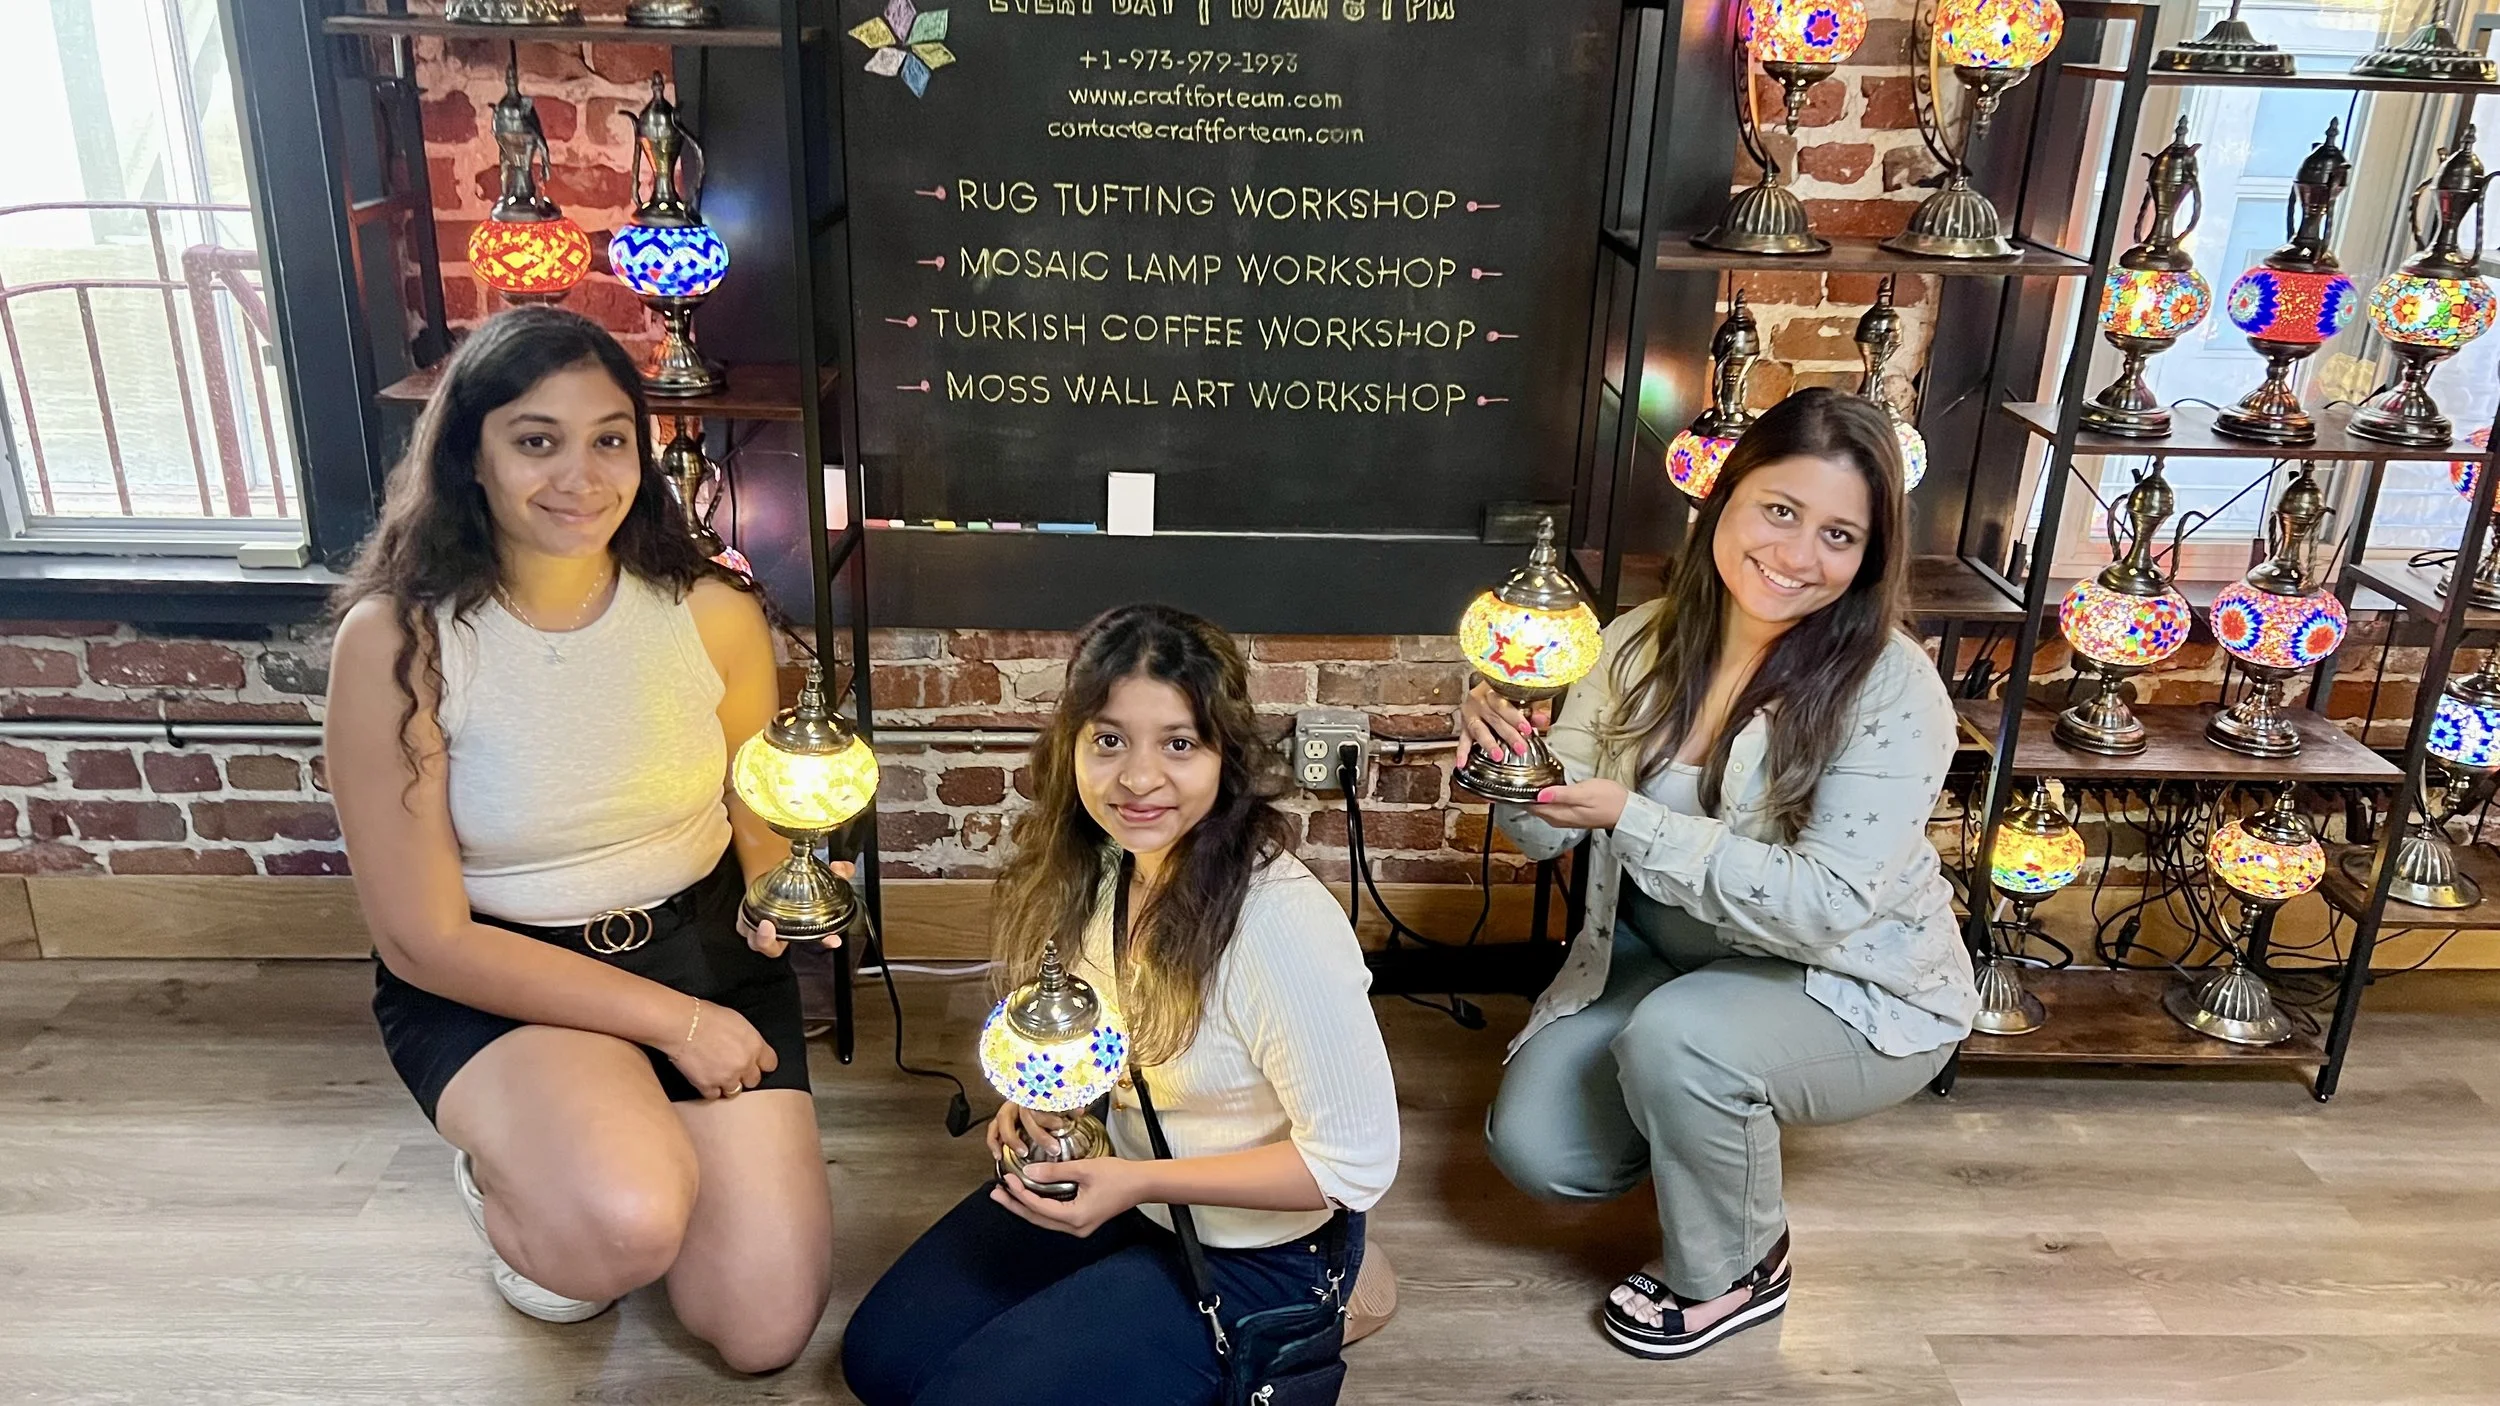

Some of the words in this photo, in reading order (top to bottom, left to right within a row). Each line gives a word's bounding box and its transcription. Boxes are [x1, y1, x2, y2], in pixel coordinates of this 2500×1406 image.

[1080, 49, 1298, 75] +1-973-979-1993
[1069, 83, 1343, 110] www.craftforteam.com
[1048, 117, 1364, 145] contact@craftforteam.com
[958, 178, 1038, 214] RUG
[1053, 182, 1216, 217] TUFTING
[1230, 184, 1457, 221] WORKSHOP
[960, 246, 1109, 282] MOSAIC
[1127, 253, 1222, 286] LAMP
[1236, 254, 1457, 289] WORKSHOP
[930, 309, 1087, 343] TURKISH
[1102, 314, 1244, 348] COFFEE
[1258, 315, 1476, 352] WORKSHOP
[946, 371, 1050, 405] MOSS
[1063, 374, 1159, 407] WALL
[1171, 378, 1235, 410] ART
[1248, 380, 1466, 417] WORKSHOP
[1626, 1273, 1658, 1295] UESS
